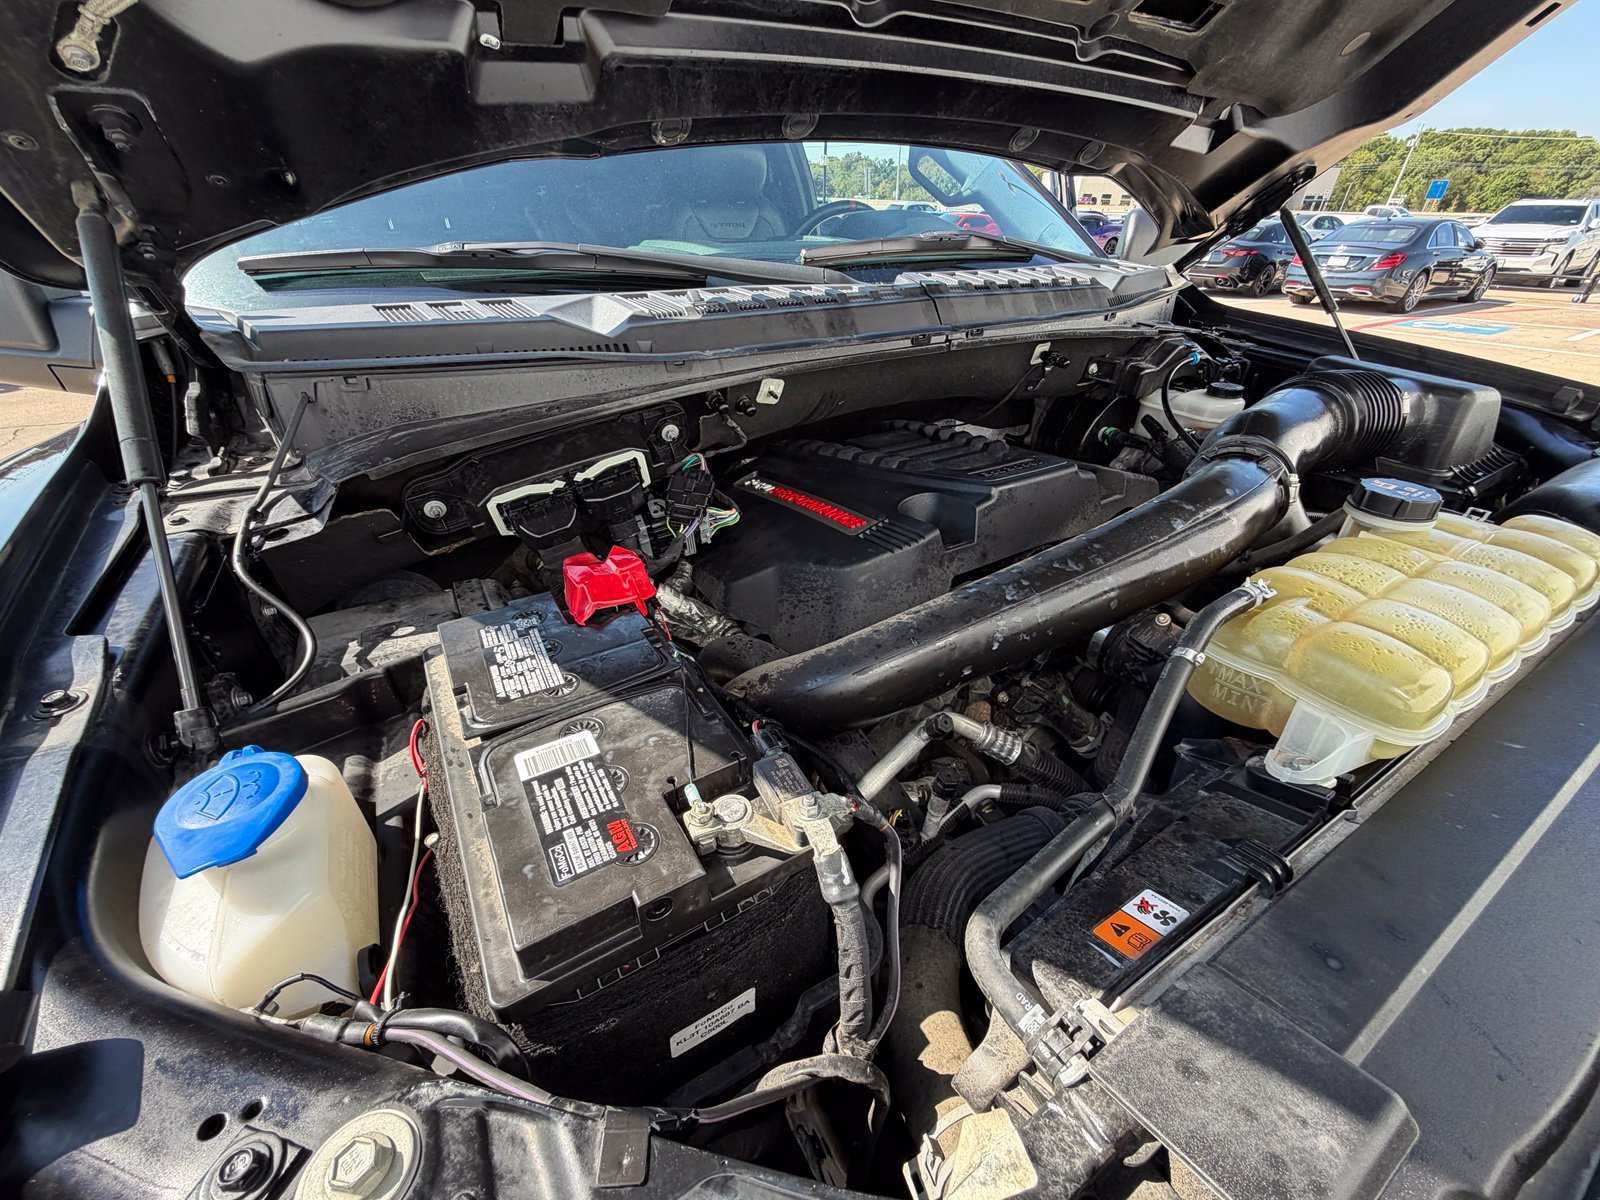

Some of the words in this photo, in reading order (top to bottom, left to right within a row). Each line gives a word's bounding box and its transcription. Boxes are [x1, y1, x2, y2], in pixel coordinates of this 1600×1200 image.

[1218, 667, 1262, 695] MAX
[1212, 682, 1259, 714] MIN
[606, 820, 632, 852] AGM
[554, 846, 571, 879] FoMoCo
[1016, 992, 1033, 1011] RAD
[694, 1004, 733, 1030] FoMoCo
[700, 1020, 729, 1038] C500L
[676, 1029, 701, 1047] KL3T
